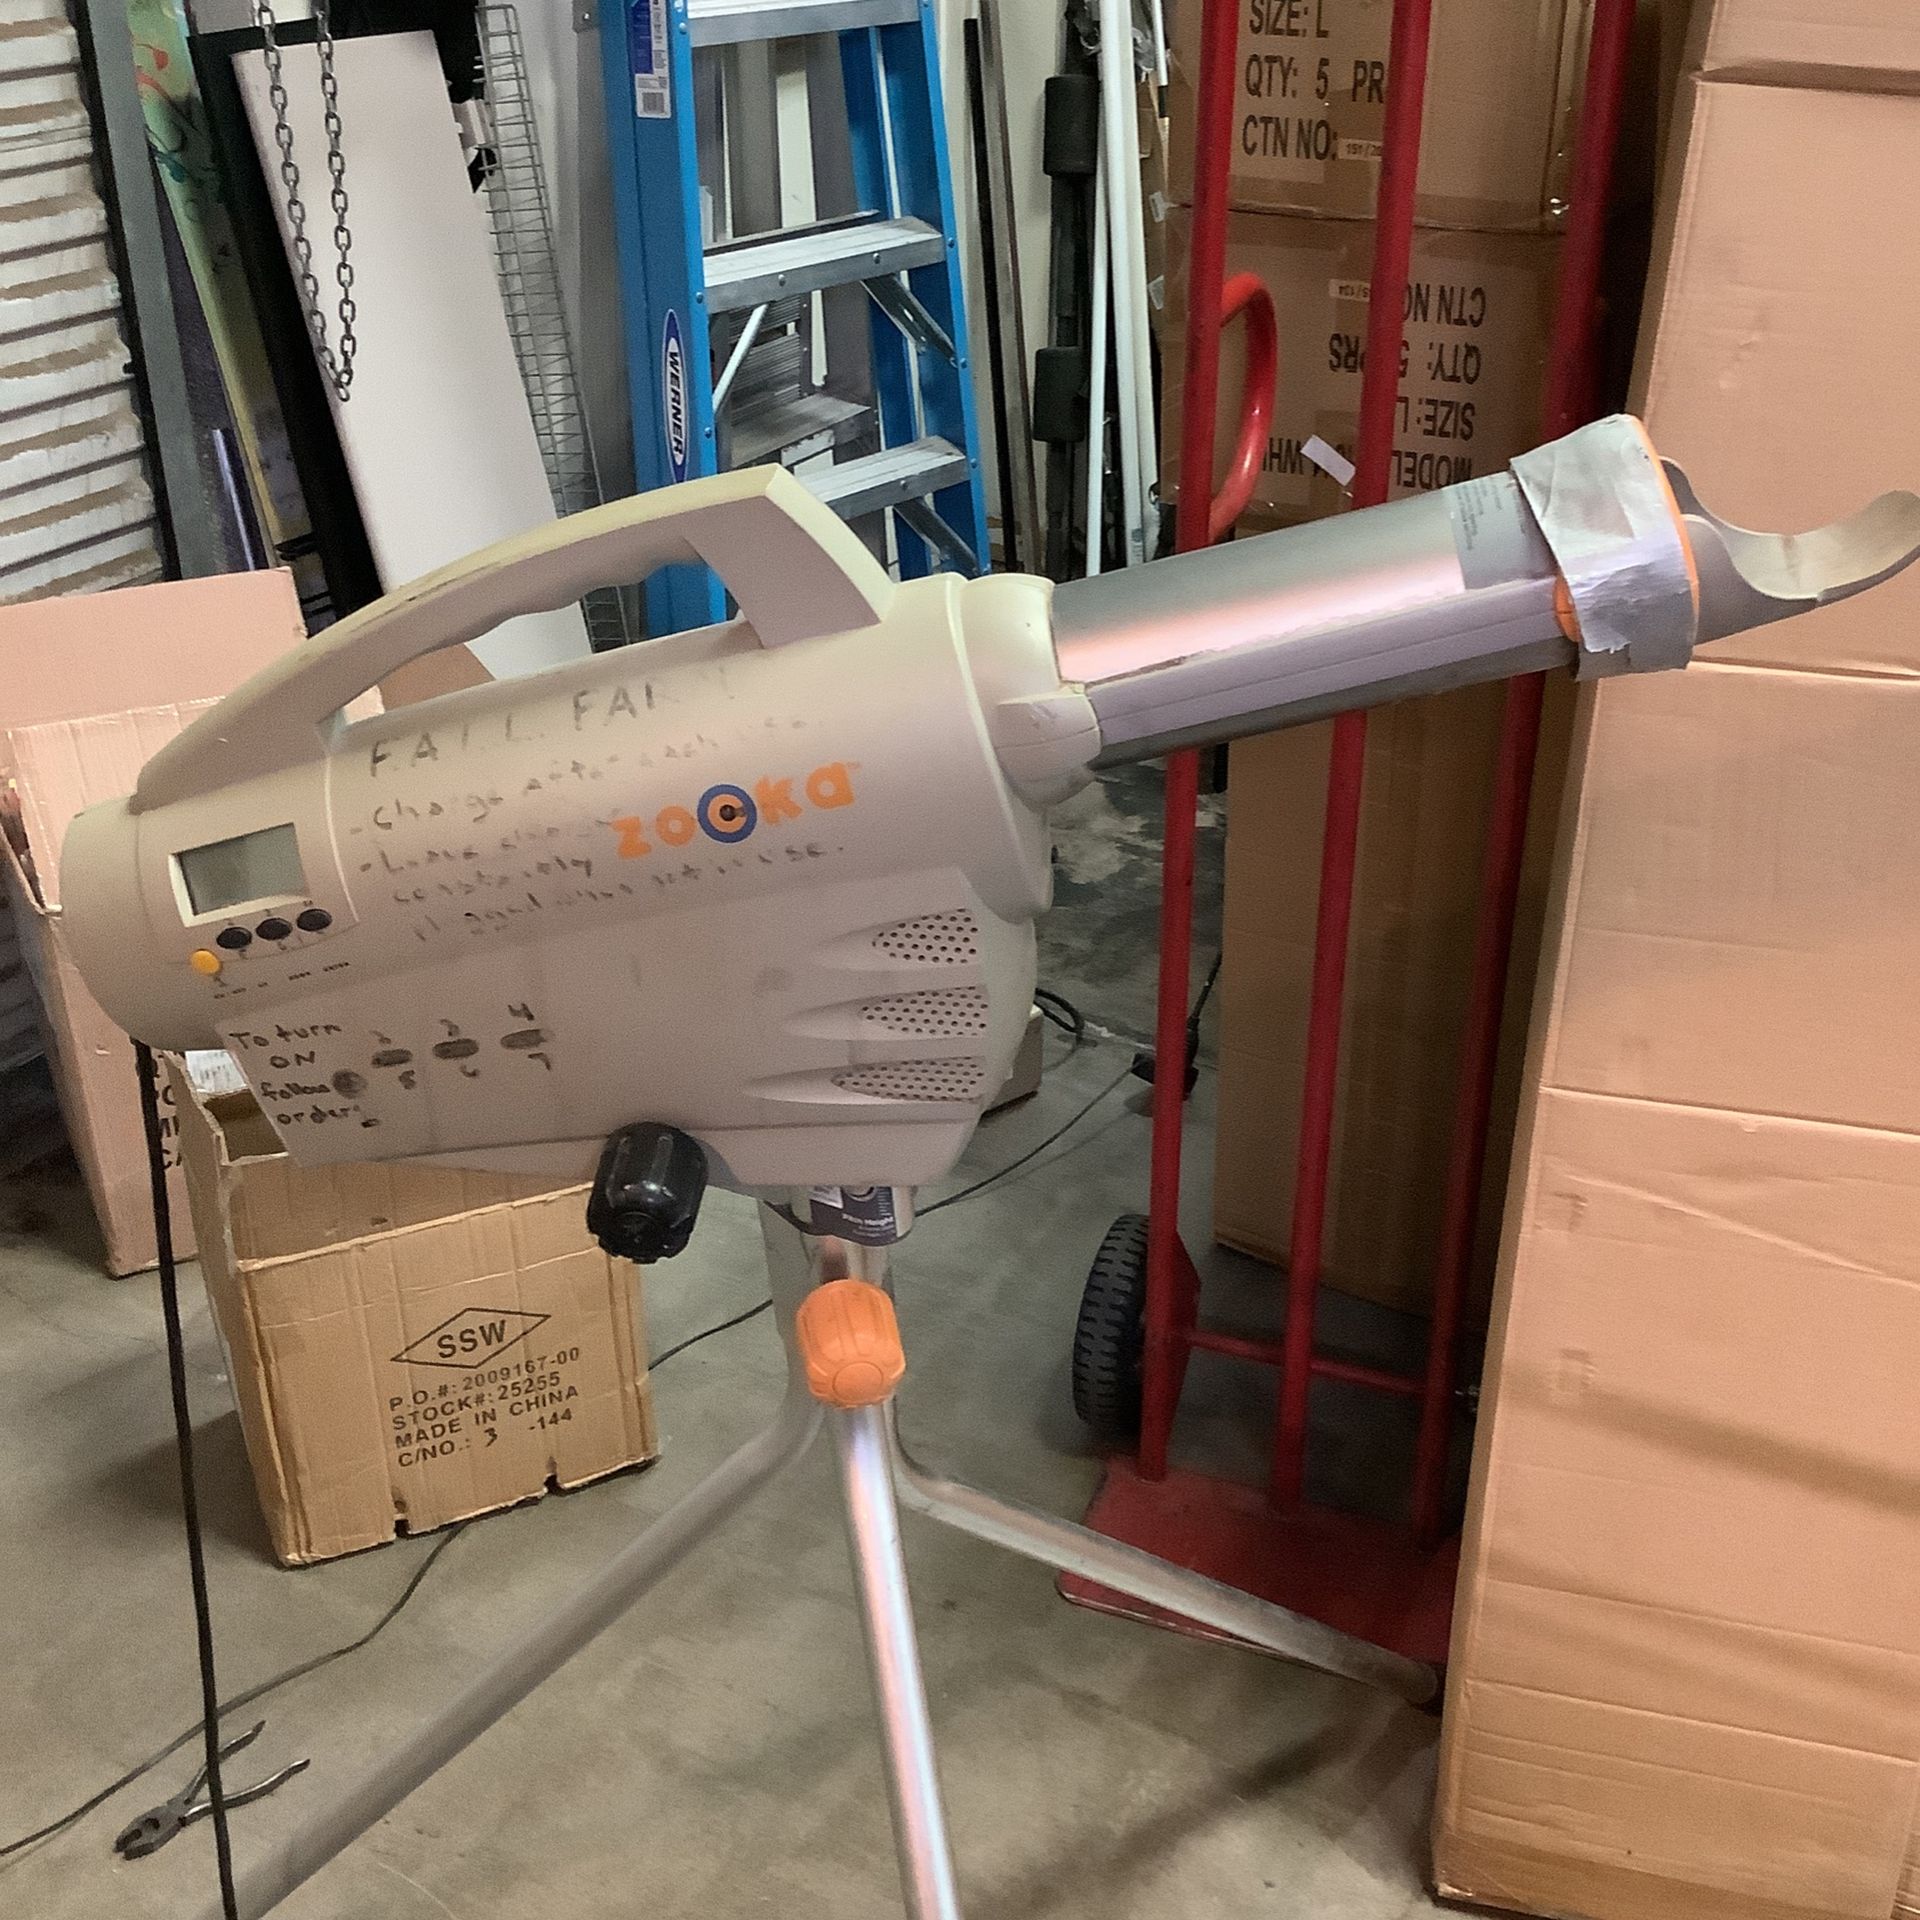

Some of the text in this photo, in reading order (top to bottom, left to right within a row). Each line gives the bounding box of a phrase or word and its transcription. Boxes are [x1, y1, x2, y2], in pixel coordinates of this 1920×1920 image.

[1316, 0, 1330, 38] L
[1245, 54, 1385, 103] QTY: 5 PR
[1242, 115, 1338, 161] CTN NO:
[1437, 286, 1486, 327] CTN
[1428, 342, 1482, 385] QTY:
[669, 351, 685, 454] WERNER
[1417, 398, 1476, 442] SIZE:
[275, 1024, 342, 1043] turn
[270, 1050, 316, 1069] ON
[437, 1319, 507, 1359] SSW
[462, 1346, 580, 1391] 2009167-00
[392, 1370, 560, 1431] STOCK#: 25255
[395, 1385, 579, 1449] MADE IN CHINA
